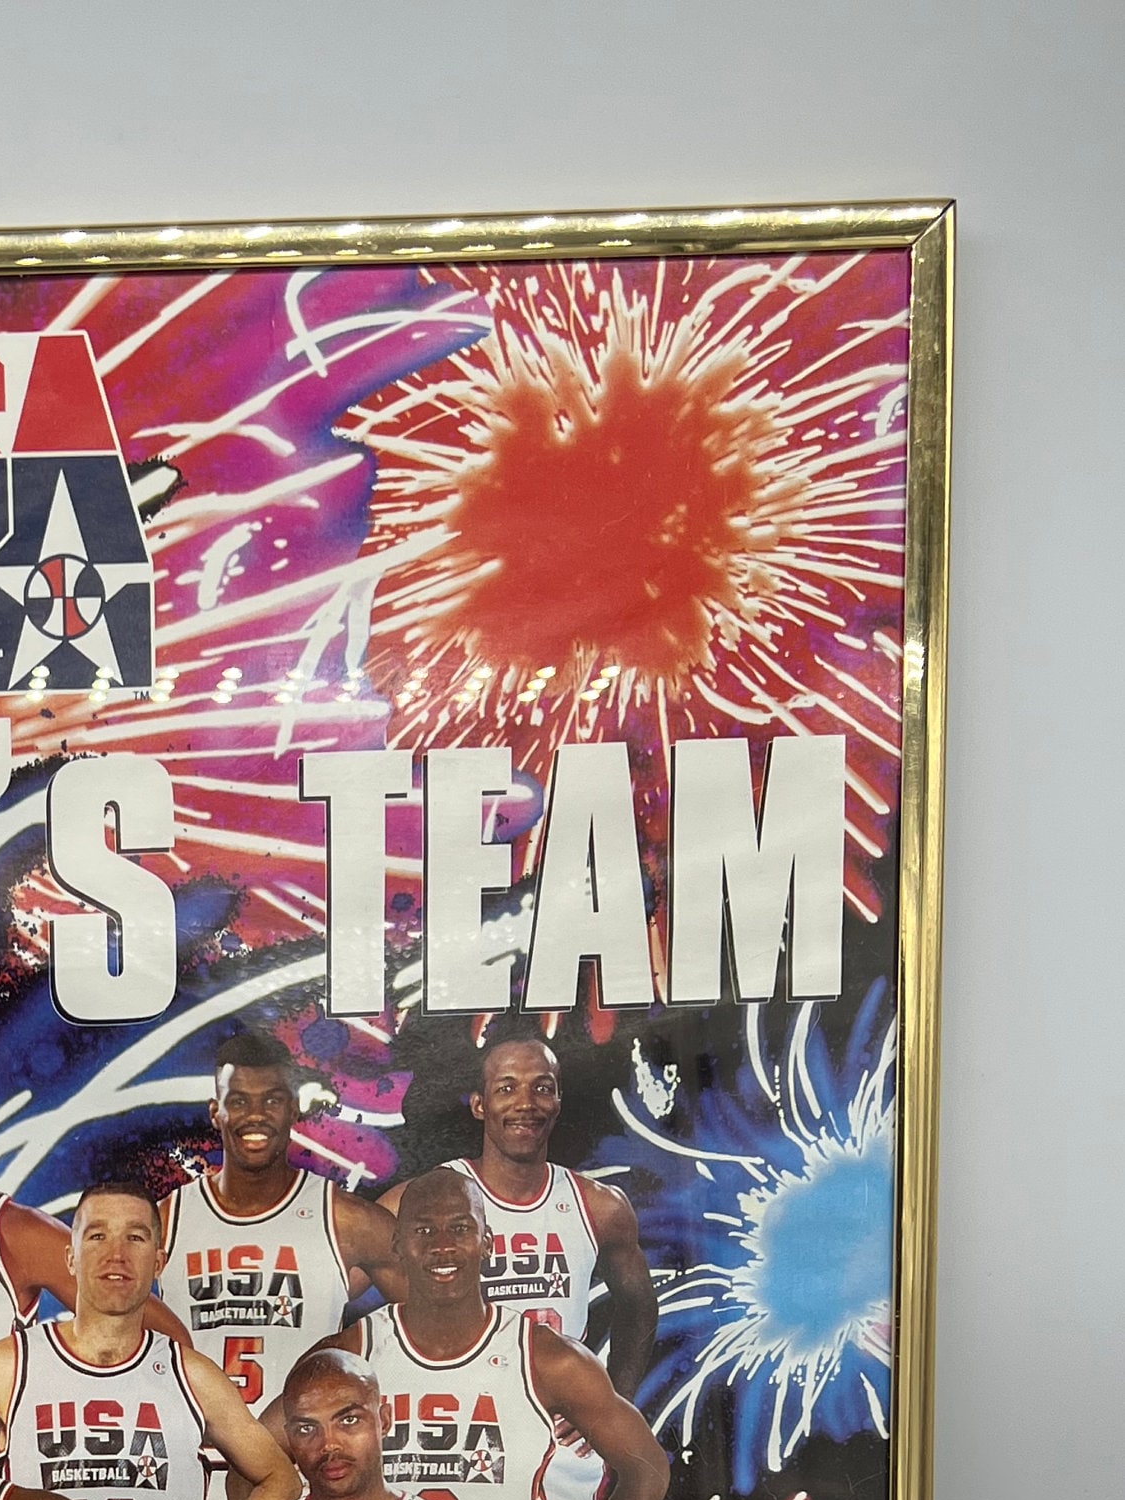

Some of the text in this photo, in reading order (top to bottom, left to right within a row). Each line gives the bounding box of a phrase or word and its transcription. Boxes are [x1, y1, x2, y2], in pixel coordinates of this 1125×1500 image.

[297, 734, 846, 1018] TEAM
[186, 1244, 304, 1301] USA
[481, 1232, 570, 1278] USA
[487, 1282, 545, 1298] BASKETBALL
[223, 1336, 265, 1405] 5
[35, 1399, 168, 1459] USA
[381, 1392, 505, 1452] USA
[51, 1466, 131, 1483] BASKETBALL
[383, 1462, 463, 1476] BASKETBALL
